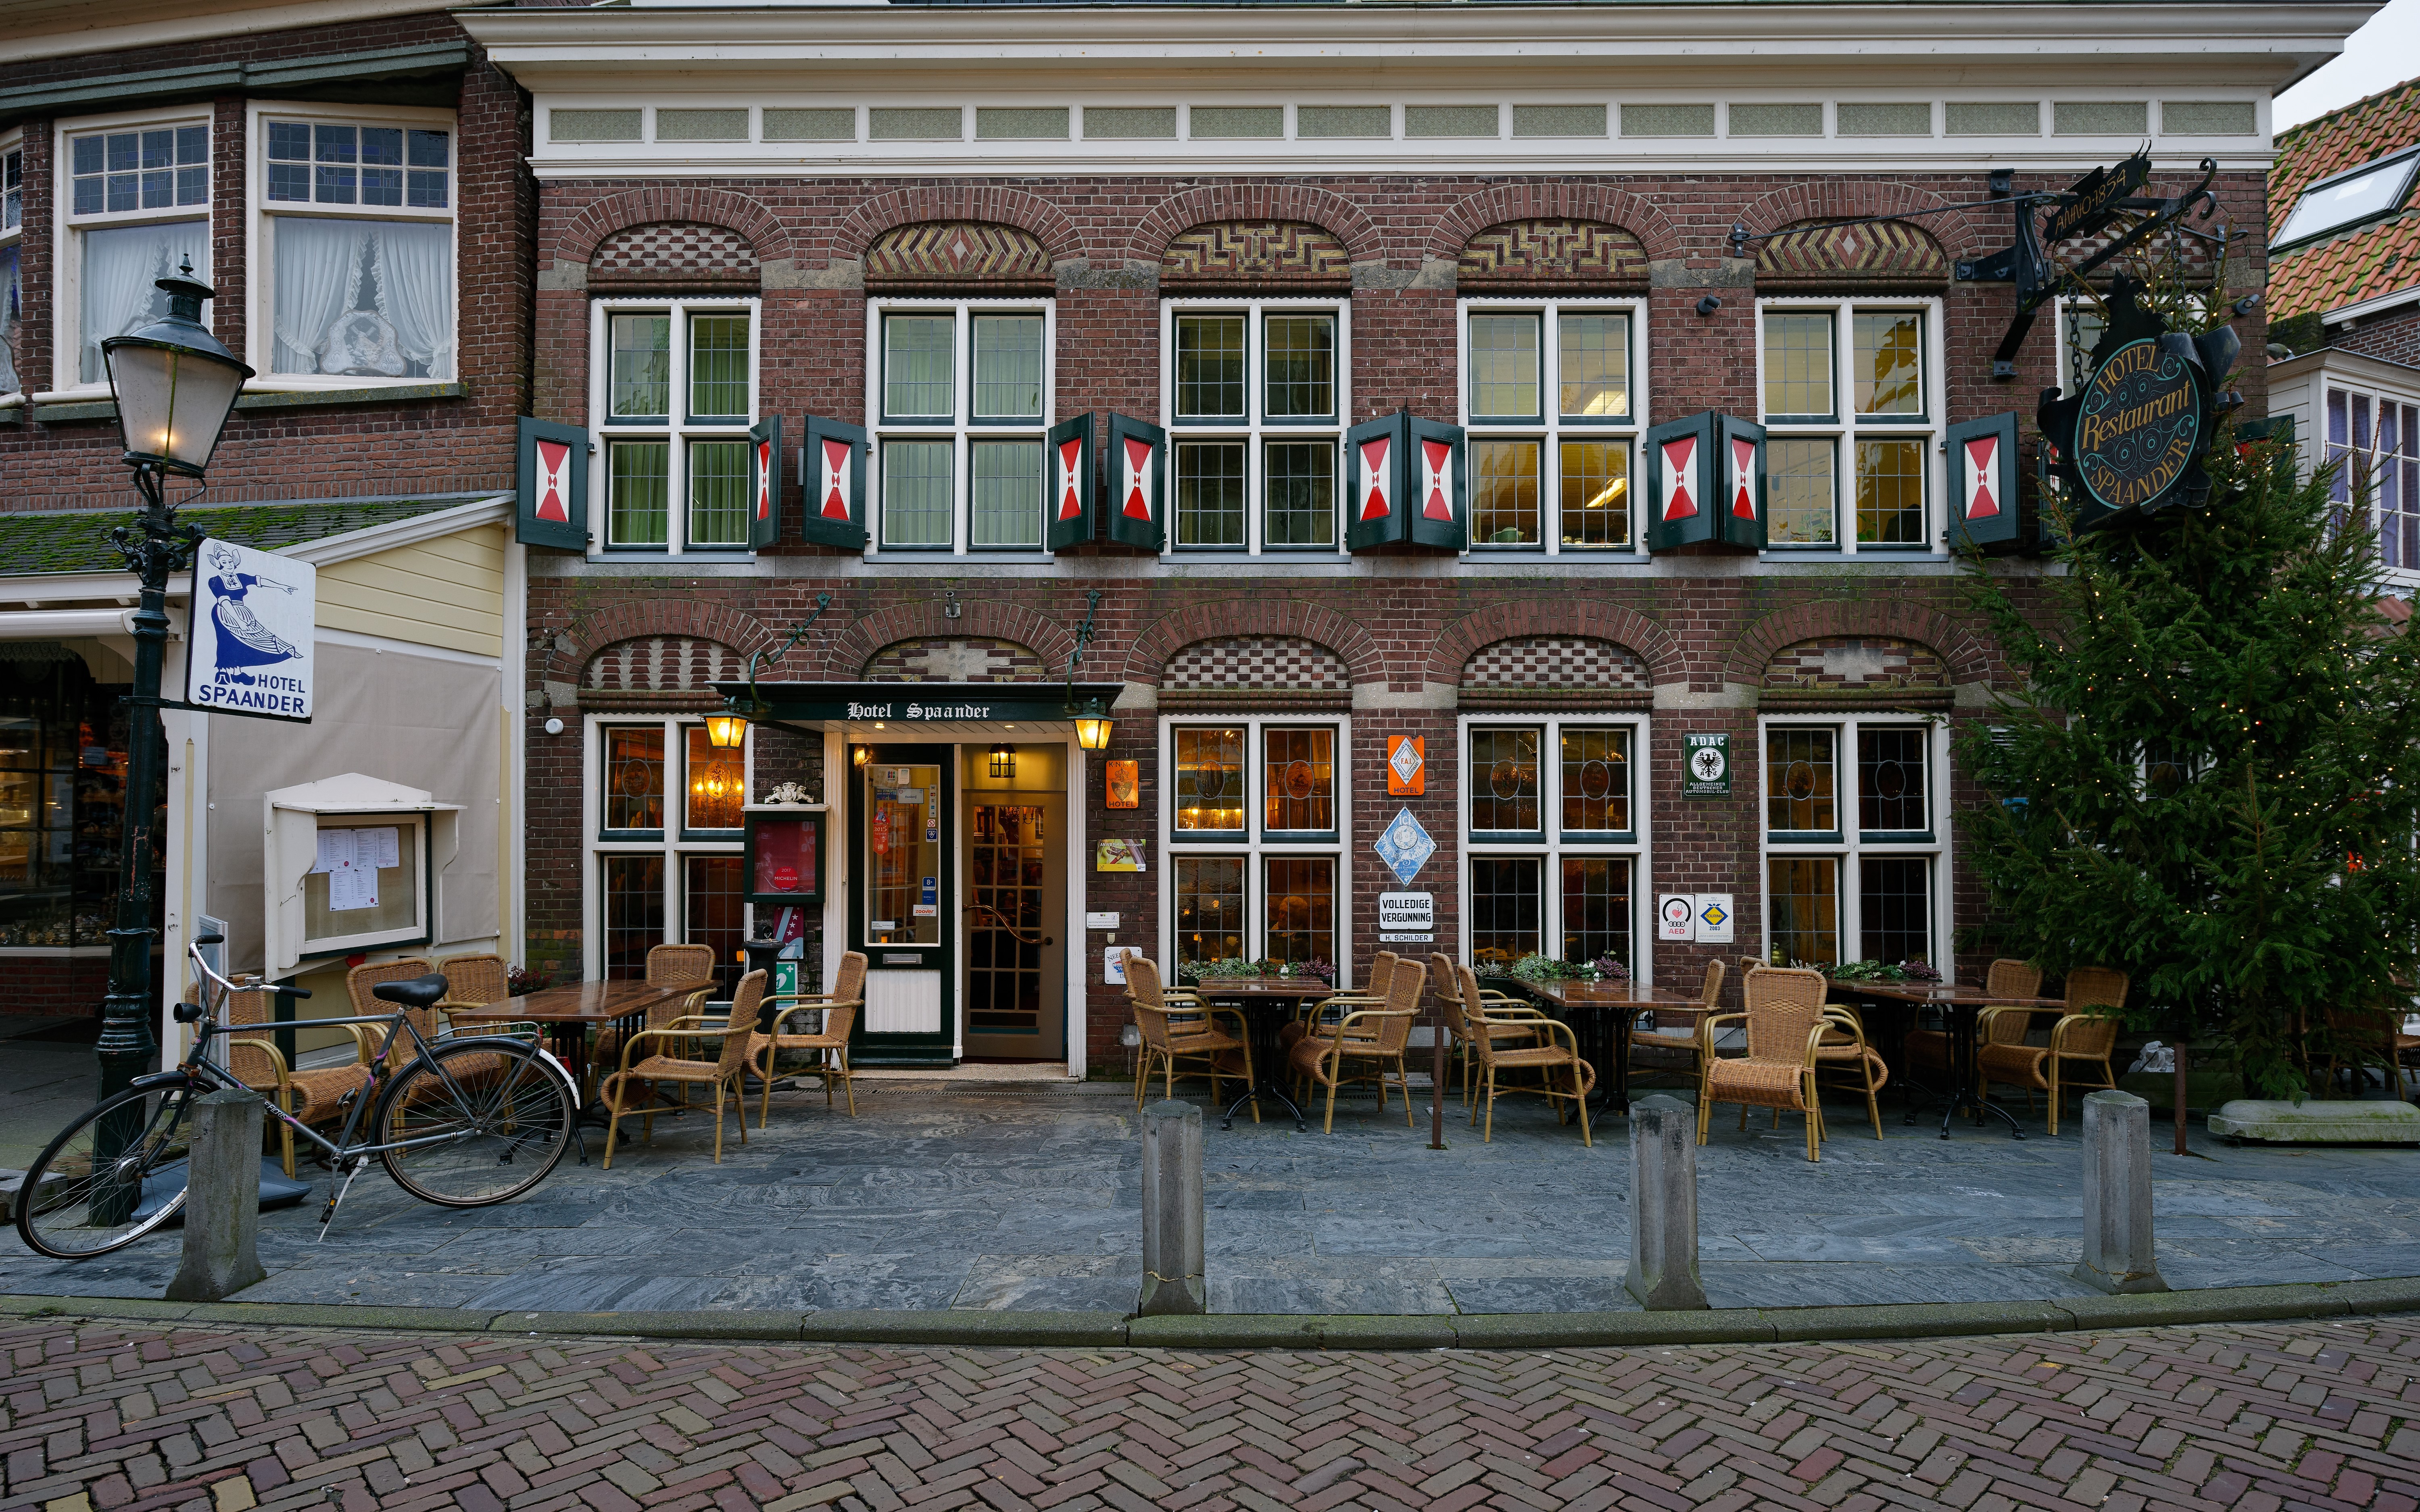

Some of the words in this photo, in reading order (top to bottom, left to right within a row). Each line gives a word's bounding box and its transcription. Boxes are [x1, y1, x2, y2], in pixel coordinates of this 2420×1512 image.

[2097, 345, 2160, 395] HOTEL
[2081, 379, 2191, 452] Restaurant
[2090, 438, 2191, 504] SPAANDER
[258, 674, 305, 693] HOTEL
[199, 685, 305, 714] SPAANDER
[847, 702, 892, 720] Hotel
[907, 703, 990, 720] Spaander
[1690, 737, 1724, 746] ADAC
[1407, 744, 1419, 760] NEDERLANDSE
[1394, 762, 1406, 778] VERENIGING
[1407, 762, 1419, 778] LUCHTVAART
[1382, 900, 1430, 908] VOLLEDIGE
[1381, 913, 1431, 922] VERGUNNING
[267, 1104, 288, 1120] FLORIS
